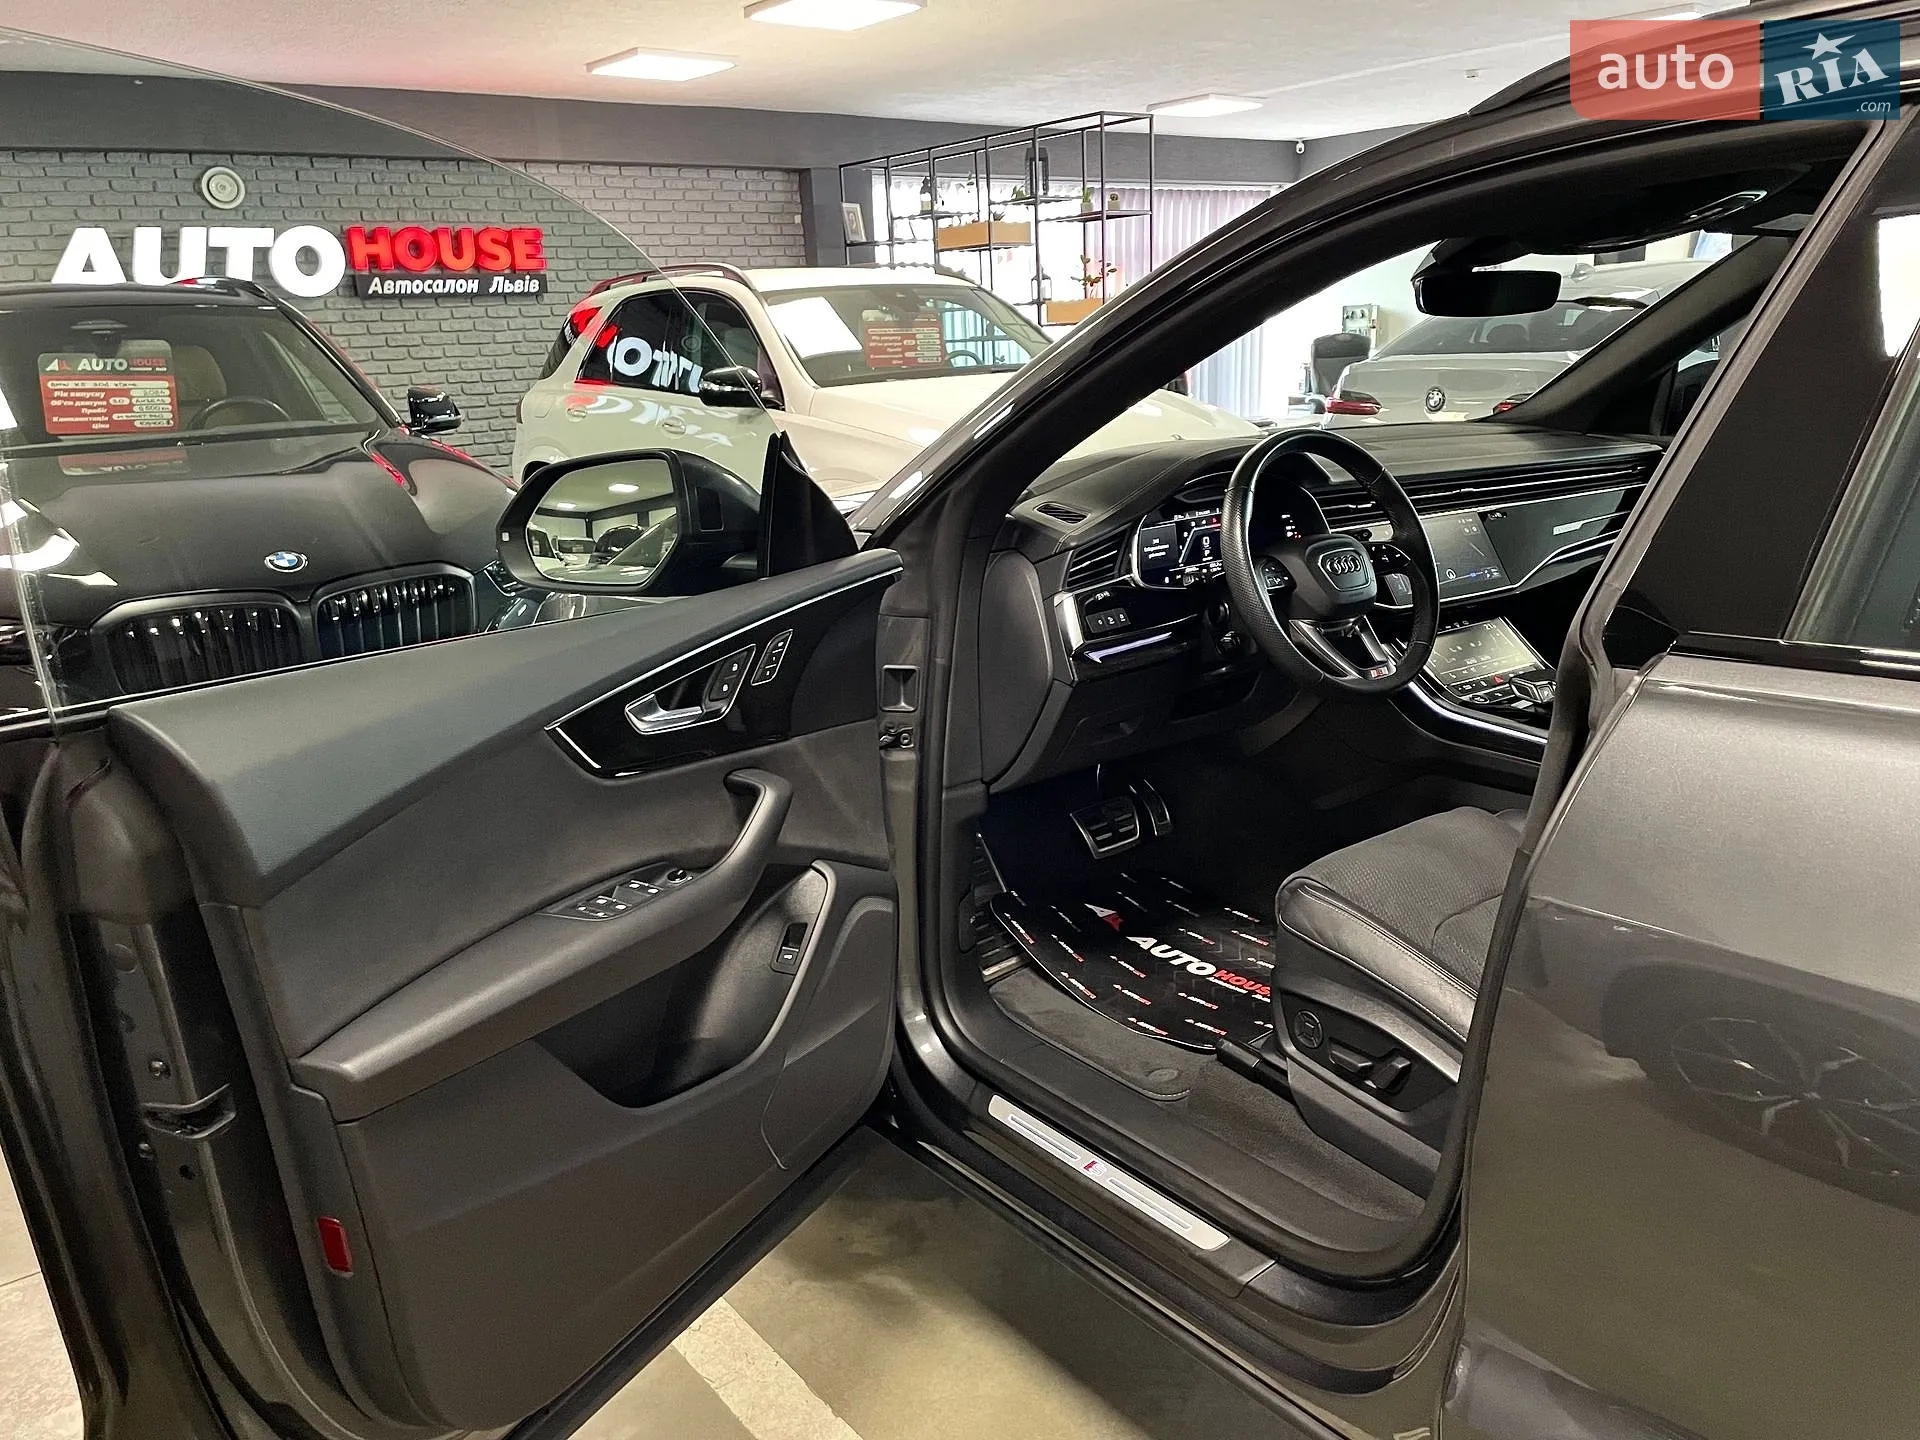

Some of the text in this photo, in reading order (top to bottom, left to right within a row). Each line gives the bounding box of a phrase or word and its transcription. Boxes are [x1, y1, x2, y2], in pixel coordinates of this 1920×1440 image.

[51, 225, 546, 297] AUTO HOUSE
[368, 275, 540, 294] Автосалон Львів
[78, 358, 128, 371] AUTO
[1126, 936, 1217, 976] AUTO
[1213, 969, 1271, 997] HOUS
